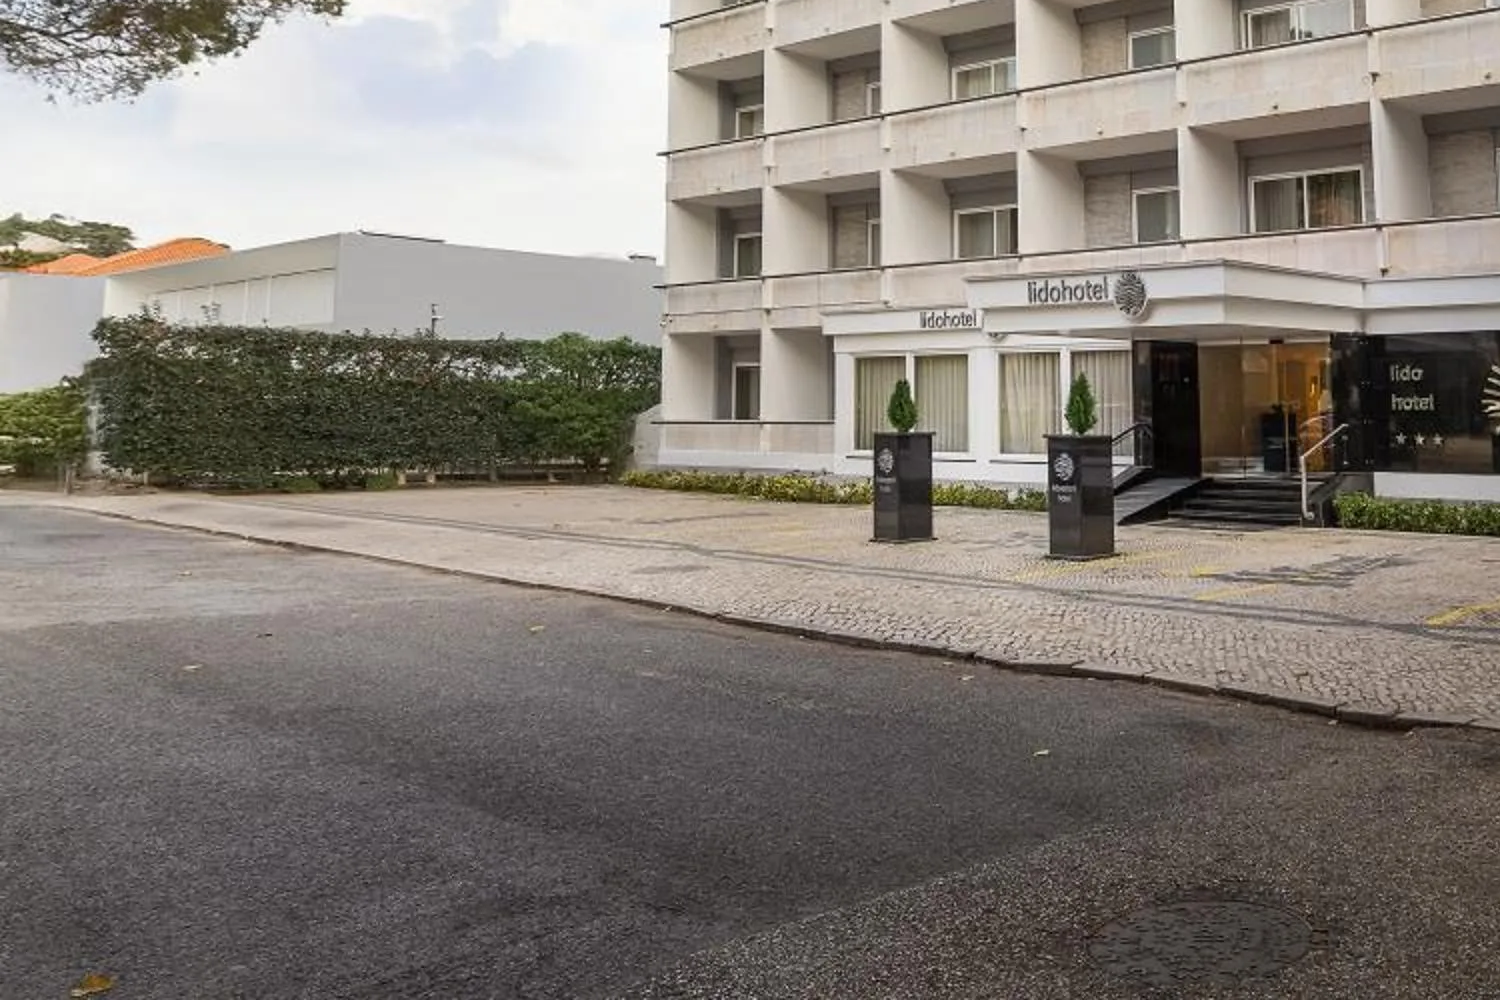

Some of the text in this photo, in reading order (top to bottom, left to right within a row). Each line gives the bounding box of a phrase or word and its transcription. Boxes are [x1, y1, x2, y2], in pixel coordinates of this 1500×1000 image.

[1028, 275, 1108, 304] lidohotel
[1389, 364, 1424, 382] lido
[1391, 393, 1434, 411] hotel
